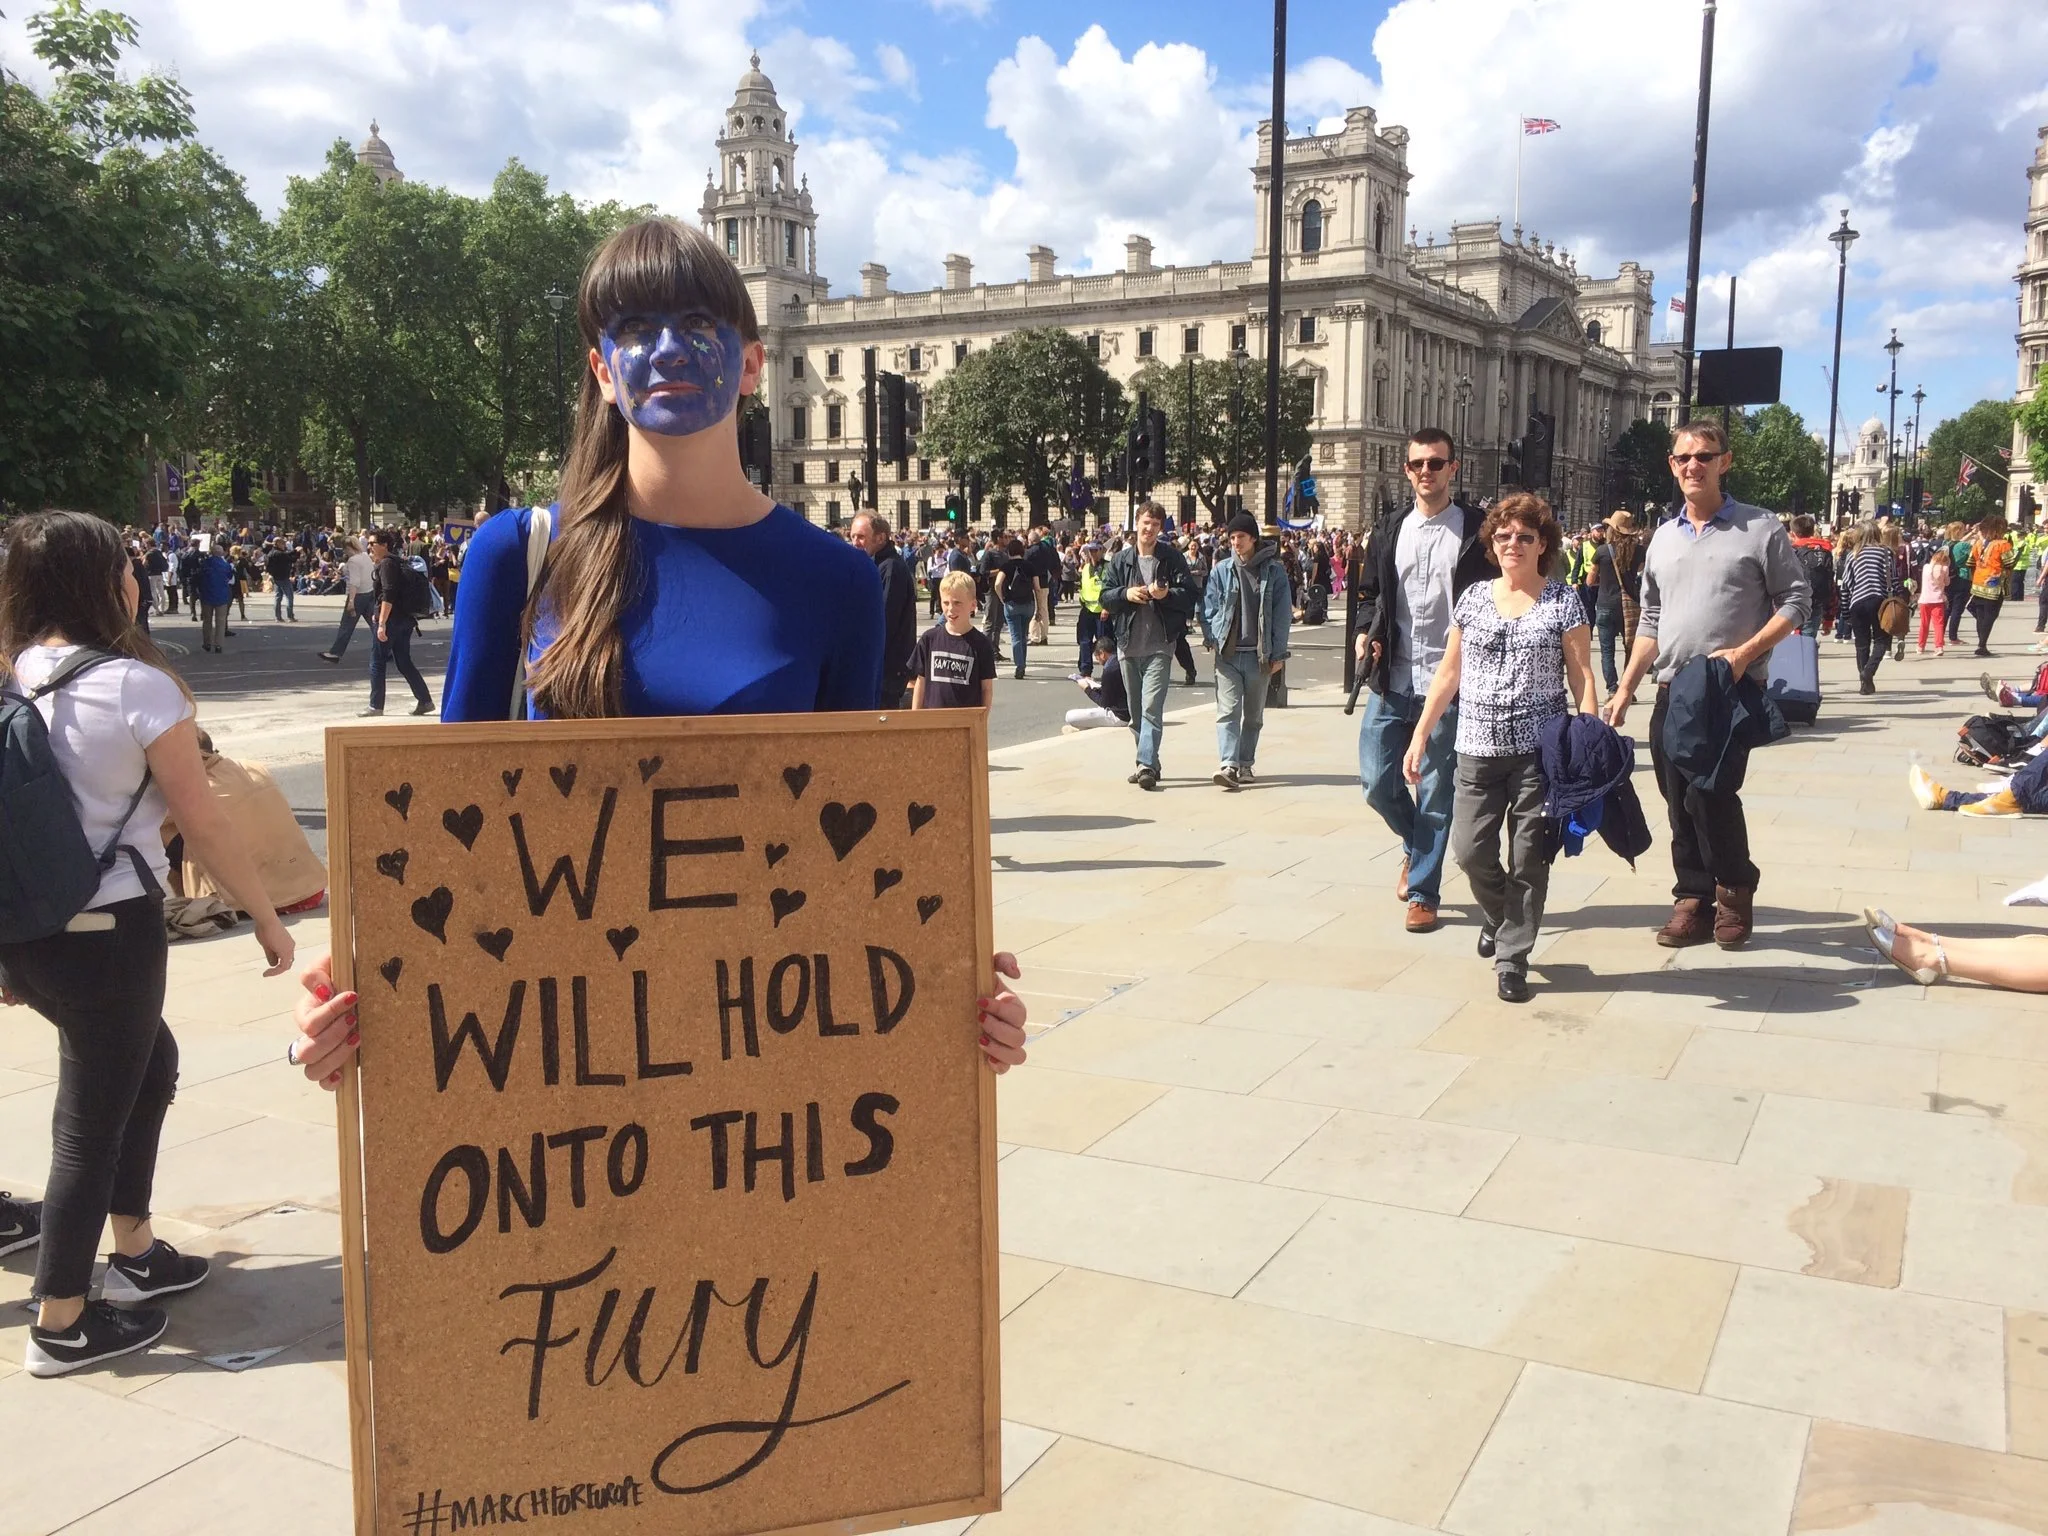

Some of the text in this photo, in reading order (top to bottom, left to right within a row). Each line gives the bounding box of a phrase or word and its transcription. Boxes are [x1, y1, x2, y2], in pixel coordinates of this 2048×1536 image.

[508, 784, 745, 920] WE
[427, 945, 915, 1092] WILL HOLD
[419, 1092, 900, 1254] ONTO THIS
[499, 1246, 911, 1495] Fury
